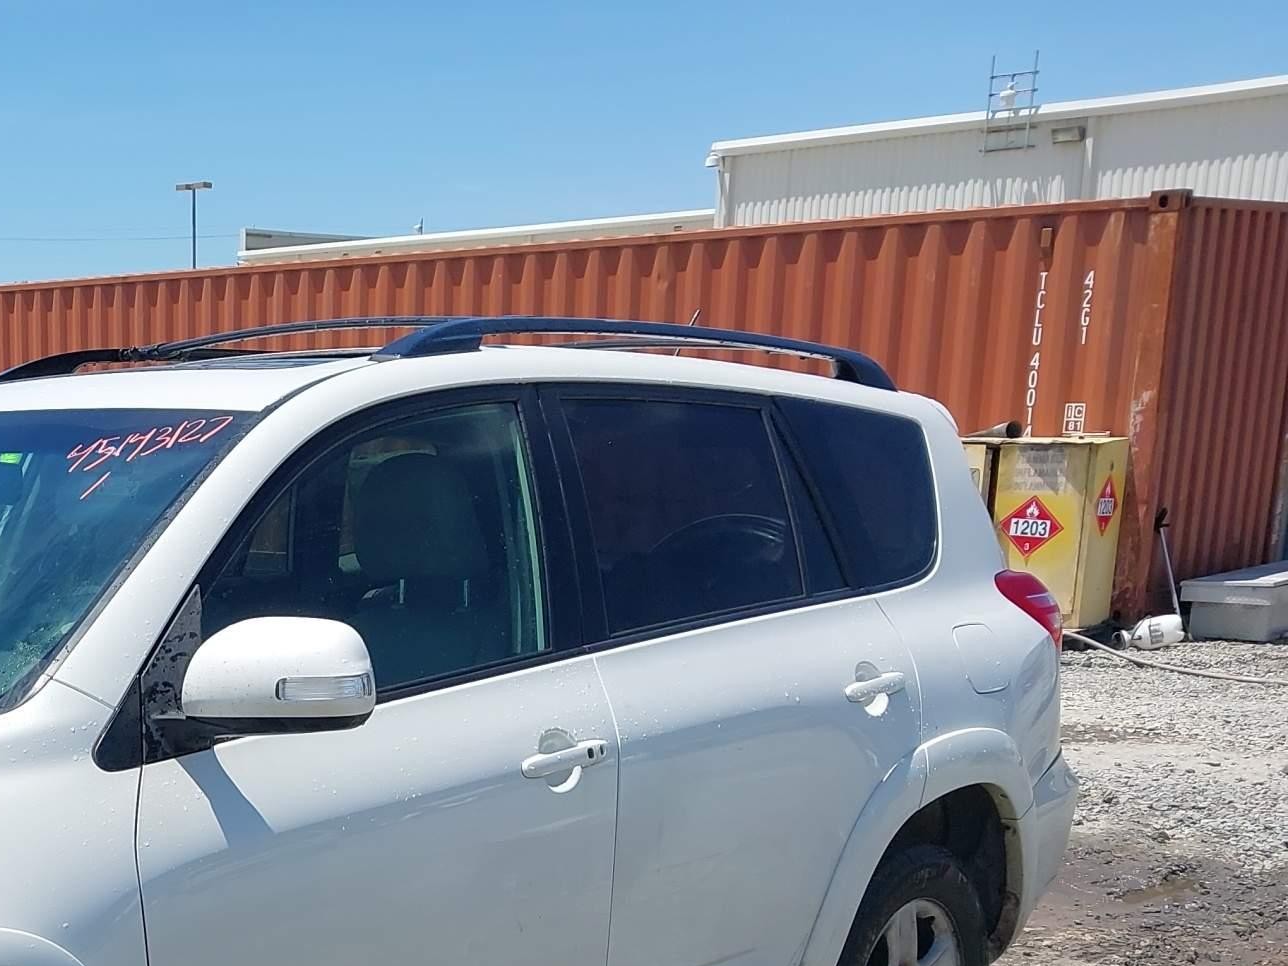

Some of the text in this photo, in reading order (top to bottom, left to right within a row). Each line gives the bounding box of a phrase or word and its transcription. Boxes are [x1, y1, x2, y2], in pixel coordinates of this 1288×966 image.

[1032, 271, 1048, 346] TCLU
[1081, 270, 1095, 345] 42G1
[67, 416, 233, 472] 45143127
[1067, 421, 1082, 432] 81
[1013, 519, 1048, 537] 1203
[1023, 542, 1030, 551] 3
